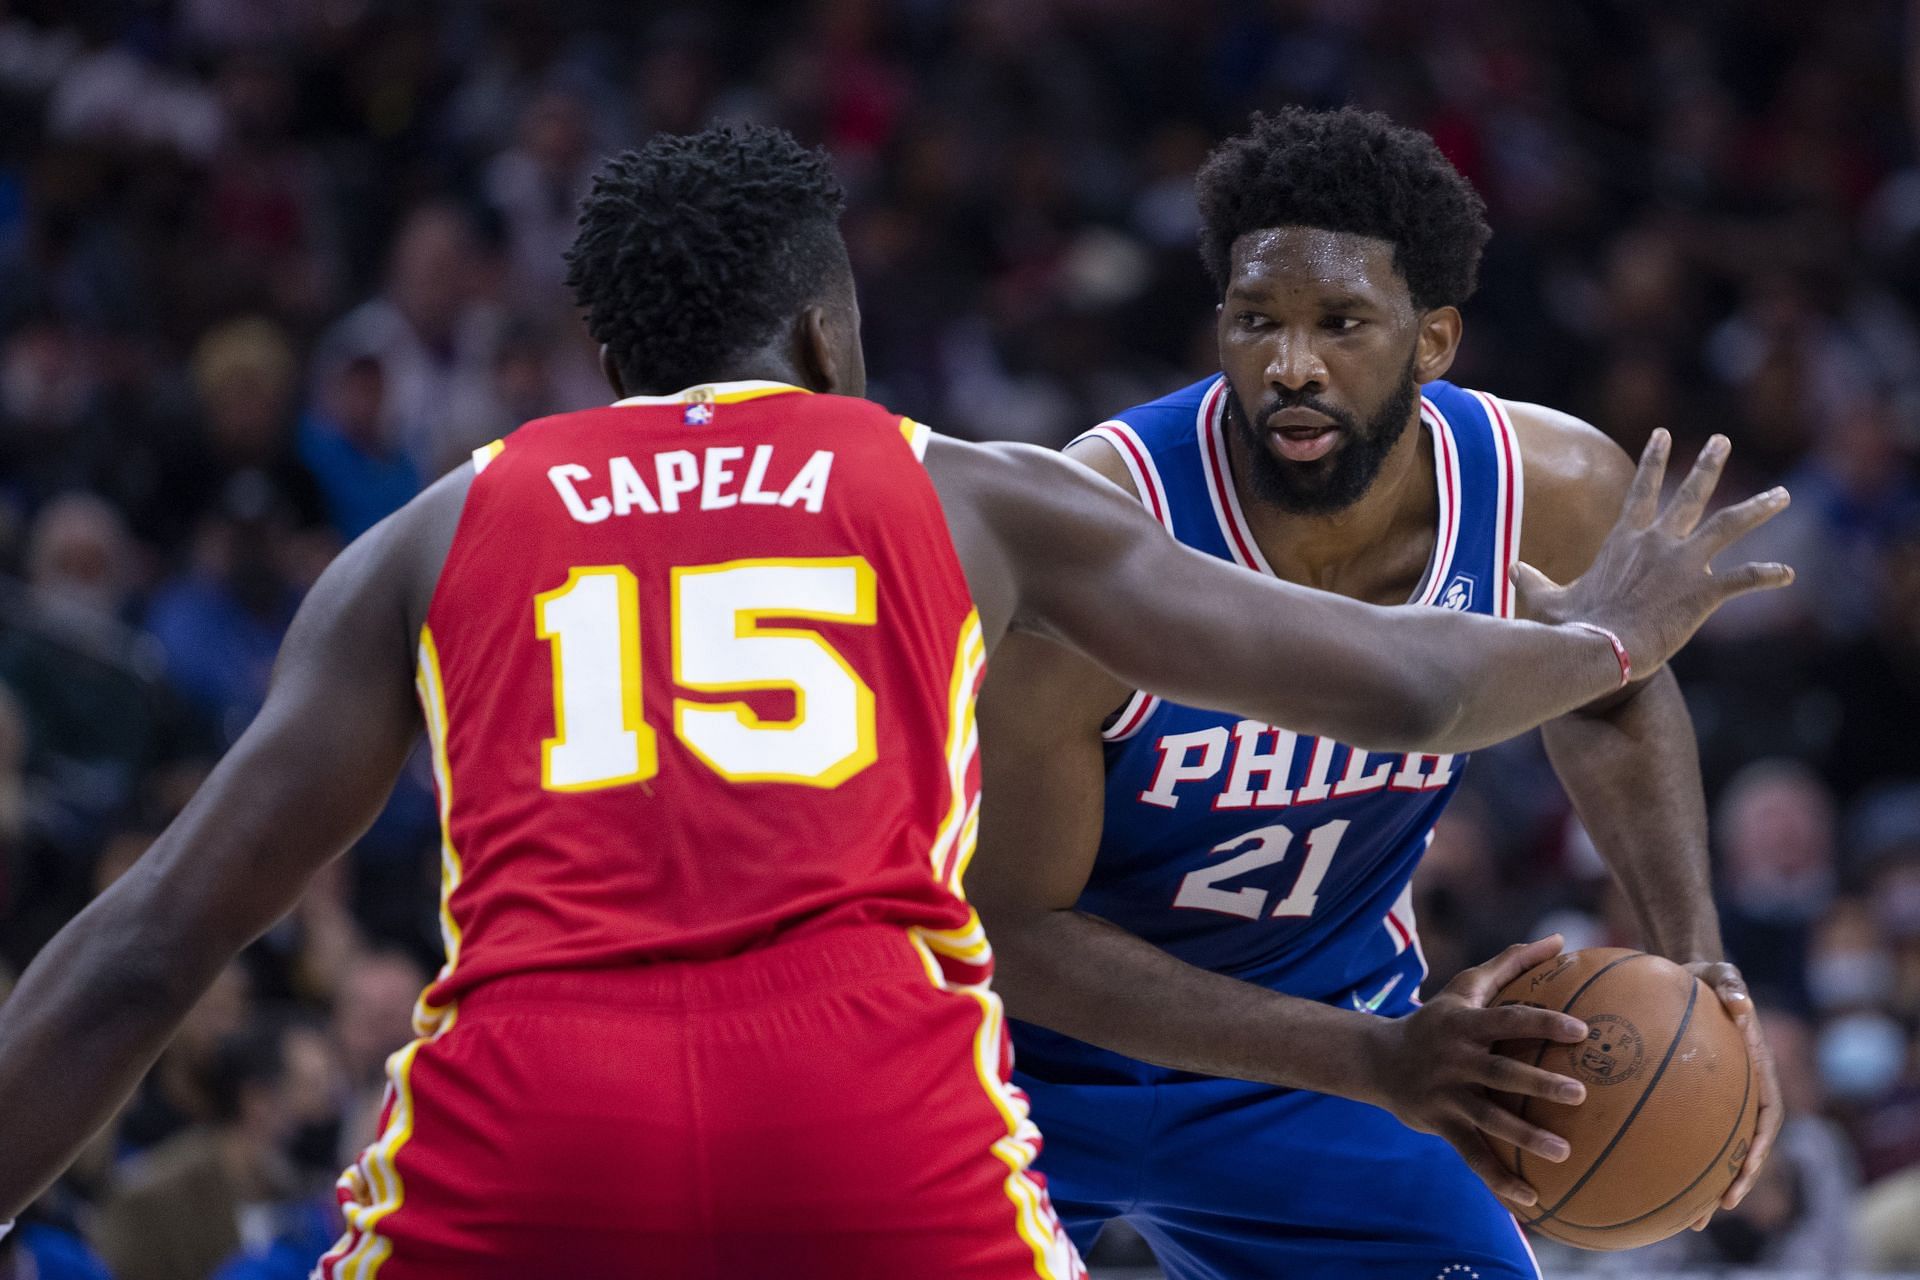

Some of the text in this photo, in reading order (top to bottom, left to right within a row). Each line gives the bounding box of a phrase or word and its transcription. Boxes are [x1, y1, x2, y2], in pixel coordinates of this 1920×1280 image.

[547, 445, 834, 523] CAPELA
[534, 556, 878, 793] 15
[1171, 819, 1351, 920] 21
